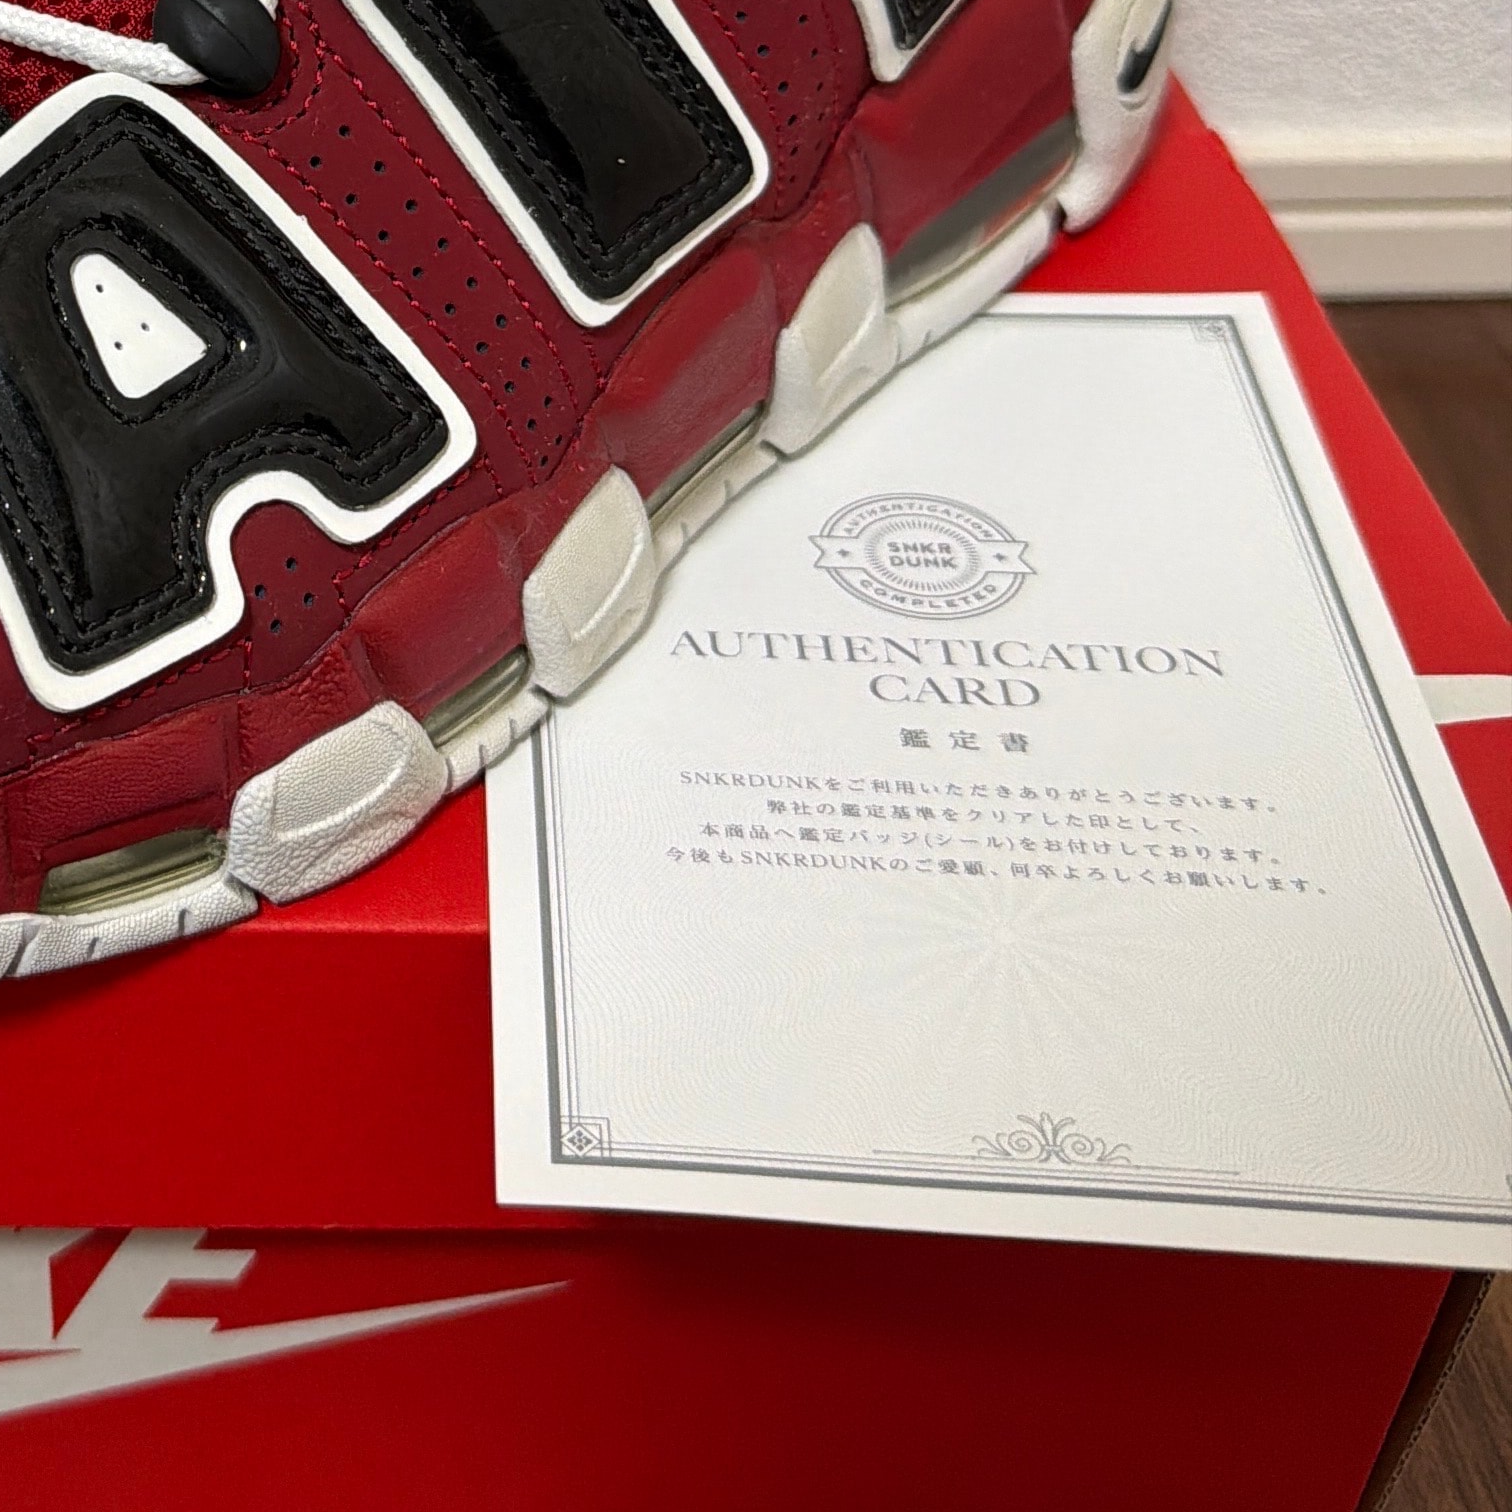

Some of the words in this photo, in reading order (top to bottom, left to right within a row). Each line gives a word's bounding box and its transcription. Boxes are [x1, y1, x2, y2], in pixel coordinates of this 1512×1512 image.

[843, 502, 994, 538] AUTHENTICATION
[886, 541, 952, 555] SNKR
[889, 555, 958, 570] DUNK
[859, 578, 997, 609] COMPLETED
[670, 629, 1227, 678] AUTHENTICATION
[868, 674, 1042, 708] CARD
[899, 727, 1030, 753] 鑑定書
